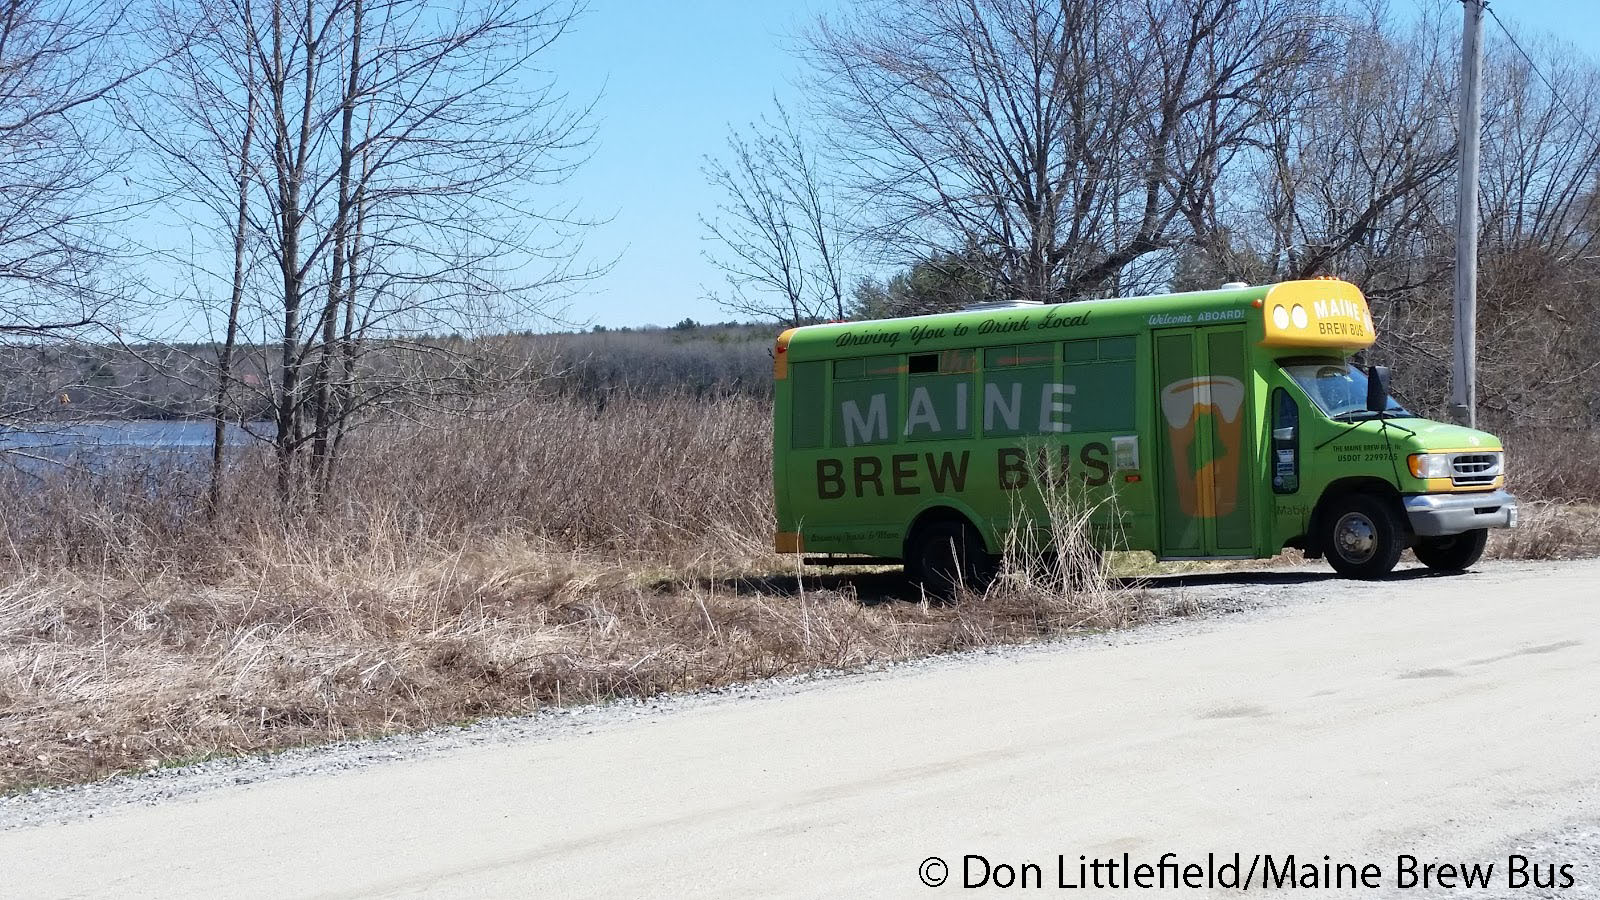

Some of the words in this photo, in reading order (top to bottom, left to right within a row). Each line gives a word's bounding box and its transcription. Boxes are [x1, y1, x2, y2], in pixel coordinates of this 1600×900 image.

[1148, 313, 1193, 325] Welcome
[1198, 309, 1245, 321] ABOARD!
[1313, 298, 1361, 321] MAINE
[836, 329, 901, 348] Driving
[910, 324, 946, 346] You
[953, 323, 969, 336] to
[977, 316, 1032, 335] Drink
[1037, 309, 1091, 330] Local
[1318, 322, 1348, 336] BREW
[1349, 323, 1364, 337] BUS
[841, 383, 1077, 447] MAINE
[1344, 444, 1362, 452] MAINE
[1337, 454, 1361, 462] USDOT
[816, 450, 971, 500] BREW
[997, 441, 1110, 490] BUS
